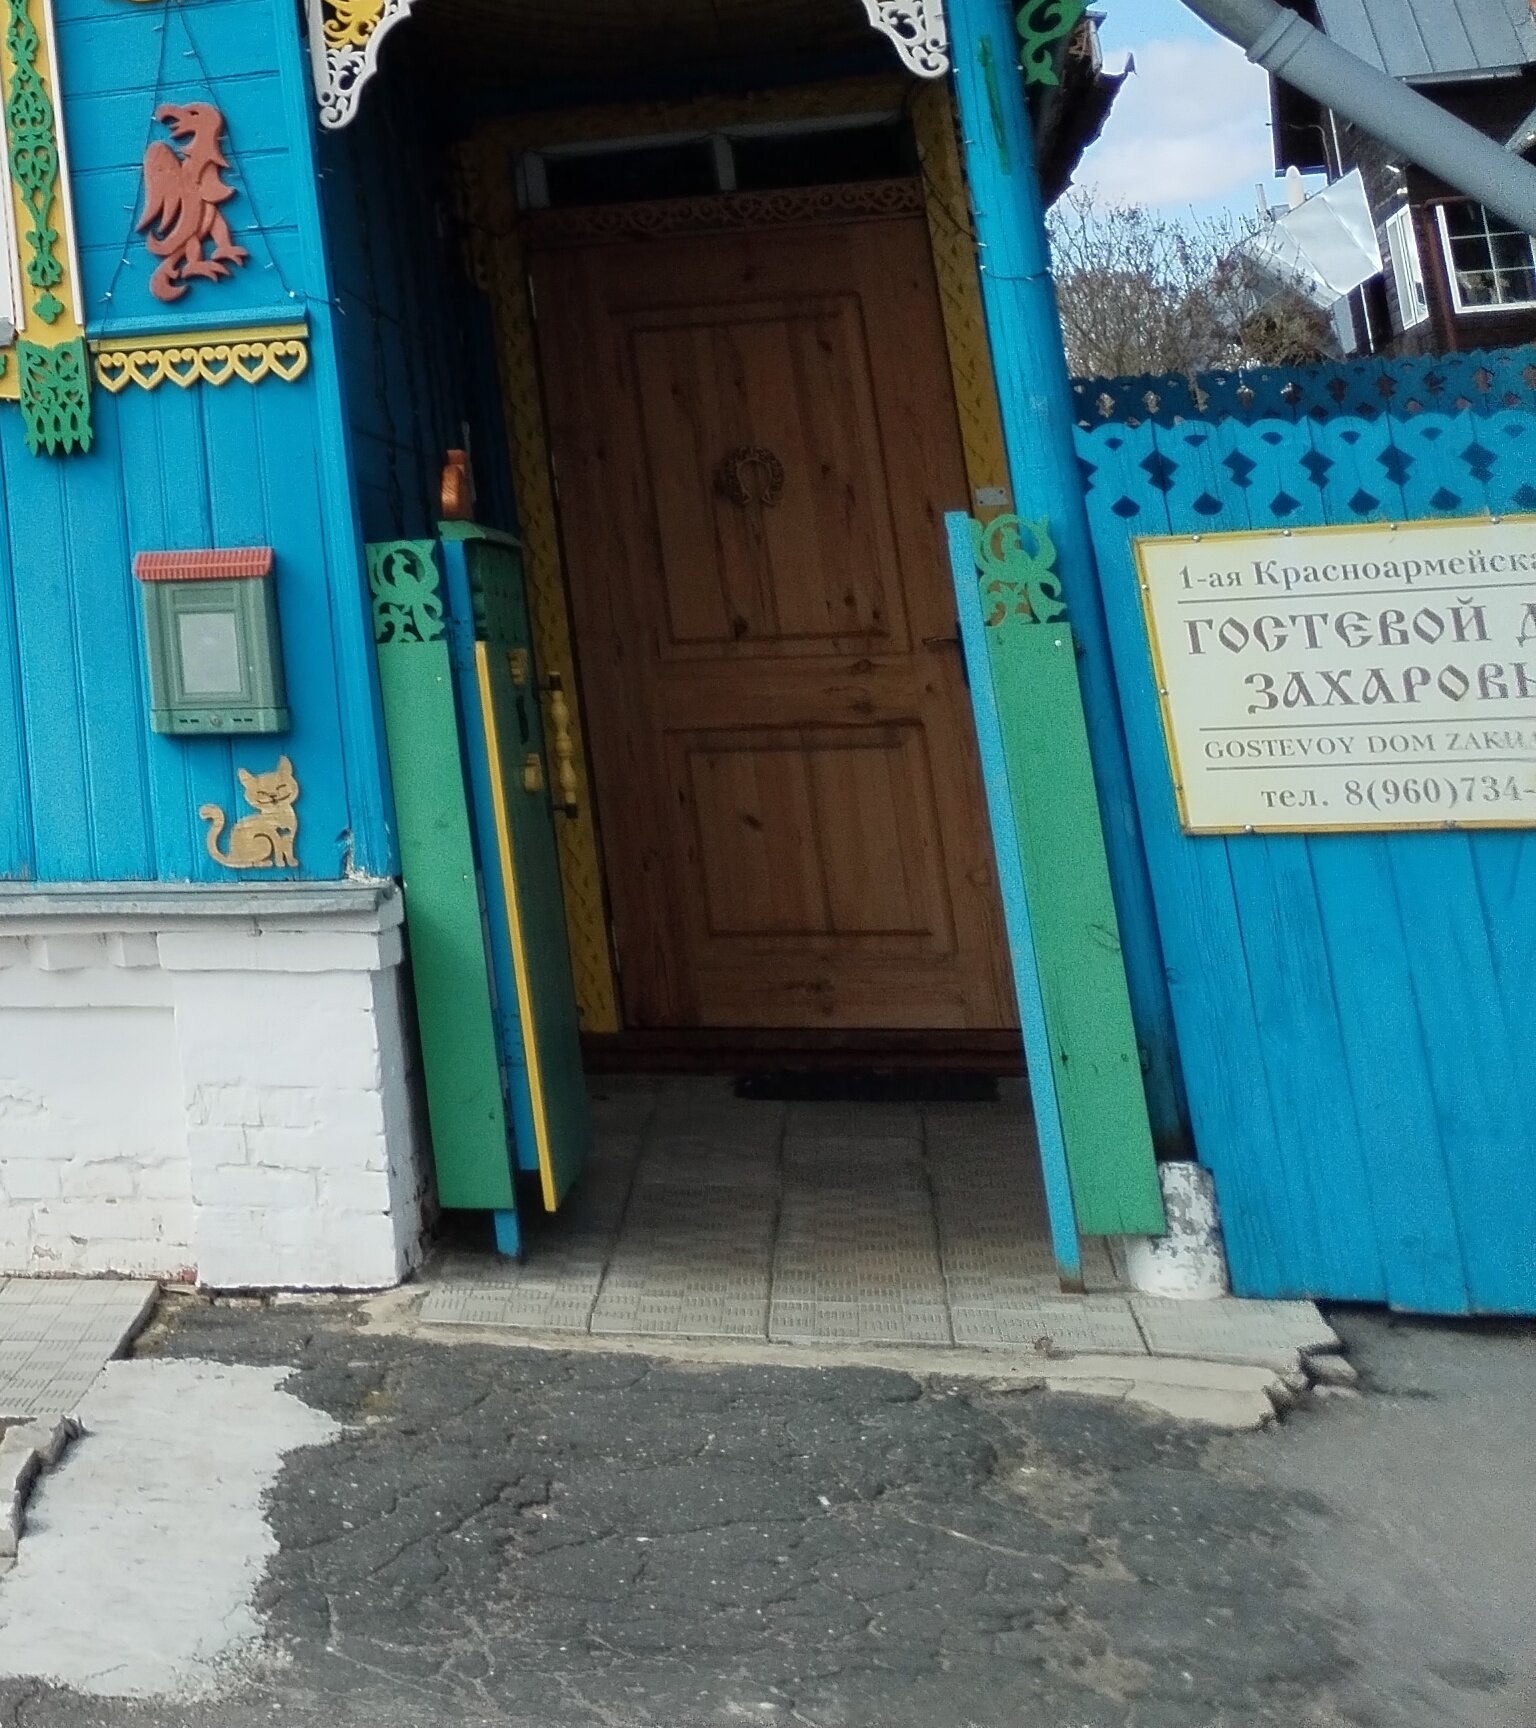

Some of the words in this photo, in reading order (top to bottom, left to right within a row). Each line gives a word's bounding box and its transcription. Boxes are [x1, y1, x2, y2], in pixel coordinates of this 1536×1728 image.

[1178, 564, 1242, 590] 1-ая
[1183, 595, 1493, 655] ГОСТЕВОЙ
[1204, 736, 1355, 759] GOSTEVOY
[1368, 733, 1436, 754] DOM
[1261, 789, 1328, 808] тел.
